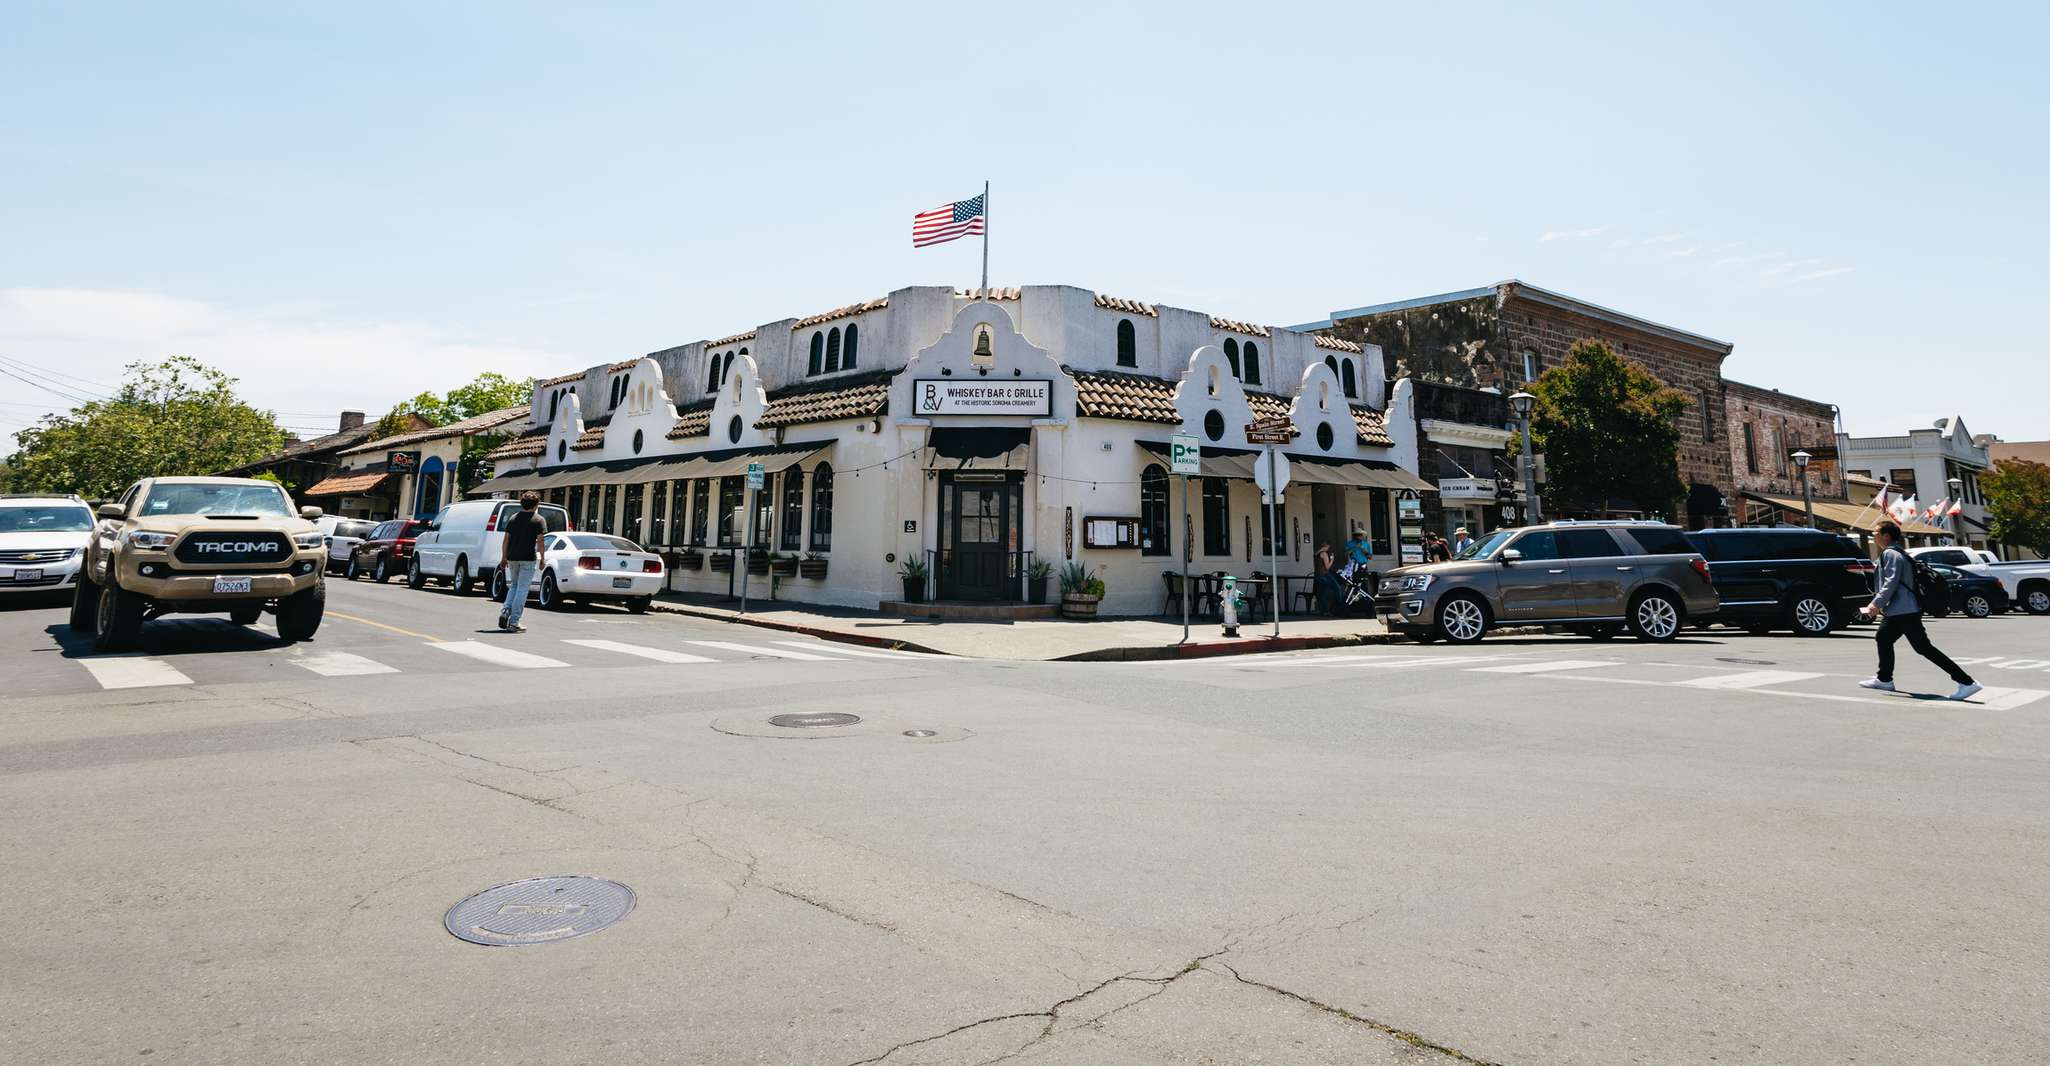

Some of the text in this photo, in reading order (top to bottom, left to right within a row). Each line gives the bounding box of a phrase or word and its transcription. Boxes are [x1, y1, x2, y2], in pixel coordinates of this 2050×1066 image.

[947, 388, 985, 398] WHISKEY
[987, 388, 1004, 398] BAR
[1014, 388, 1044, 398] GRILLE
[1174, 444, 1198, 464] PARKING
[1501, 505, 1516, 520] 408
[194, 542, 279, 553] TACOMA
